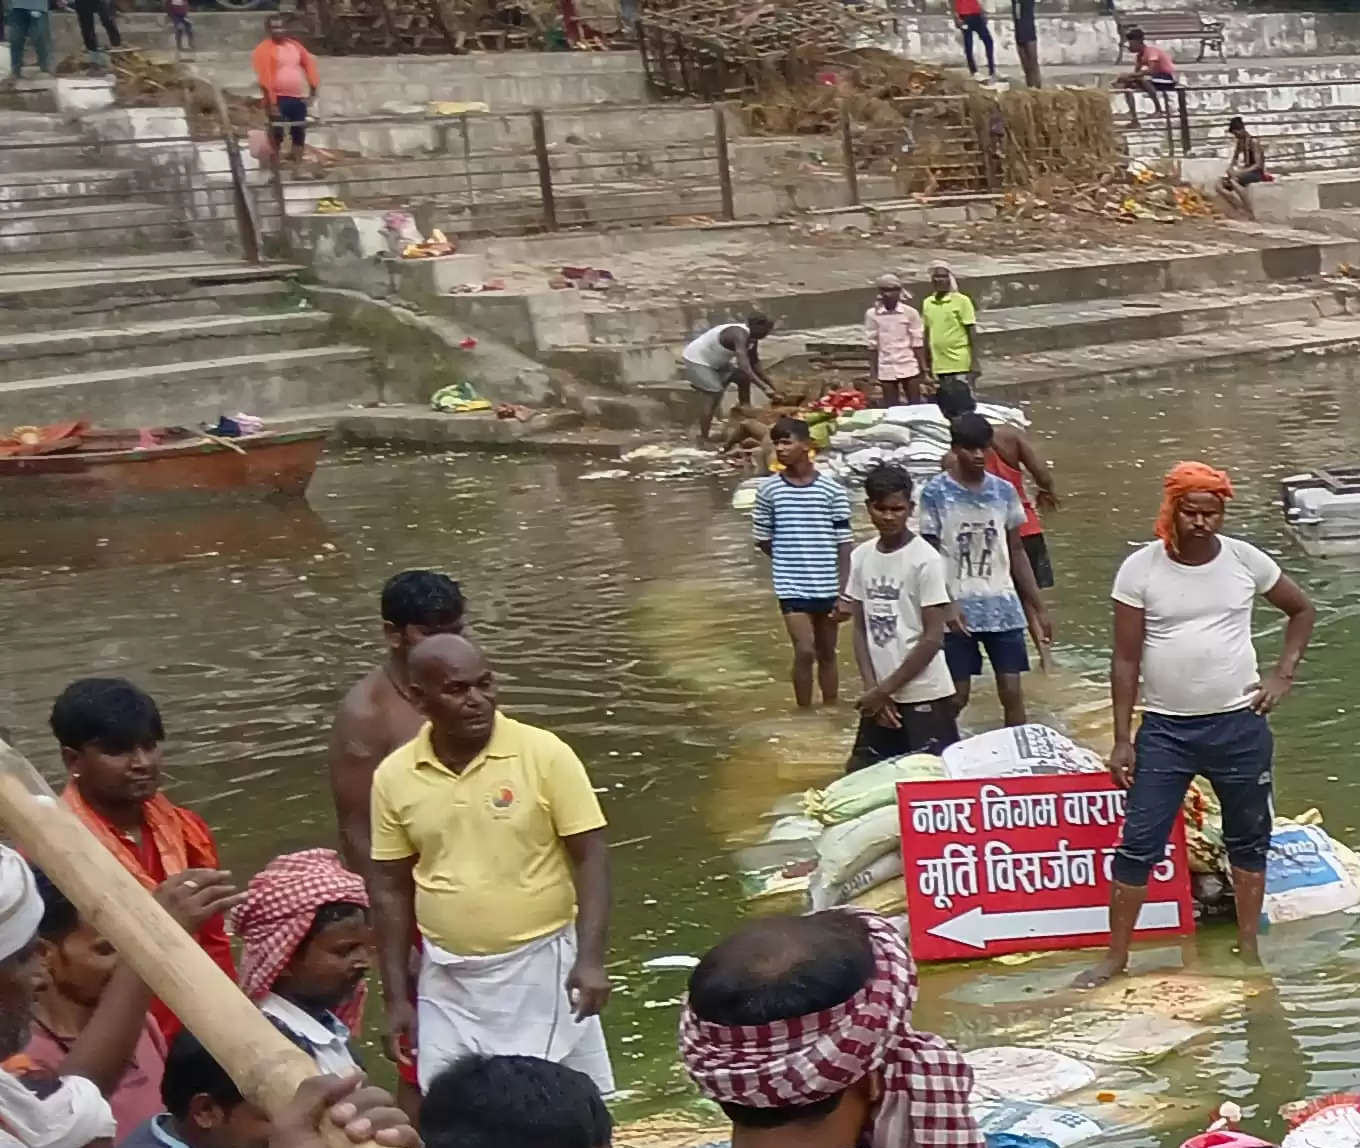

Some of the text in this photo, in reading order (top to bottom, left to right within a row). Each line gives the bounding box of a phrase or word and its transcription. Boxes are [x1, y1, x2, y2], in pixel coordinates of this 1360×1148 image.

[909, 798, 976, 834] नगर
[980, 784, 1058, 831] निगम
[916, 843, 978, 909] मूर्ति
[984, 839, 1096, 894] विसर्जन
